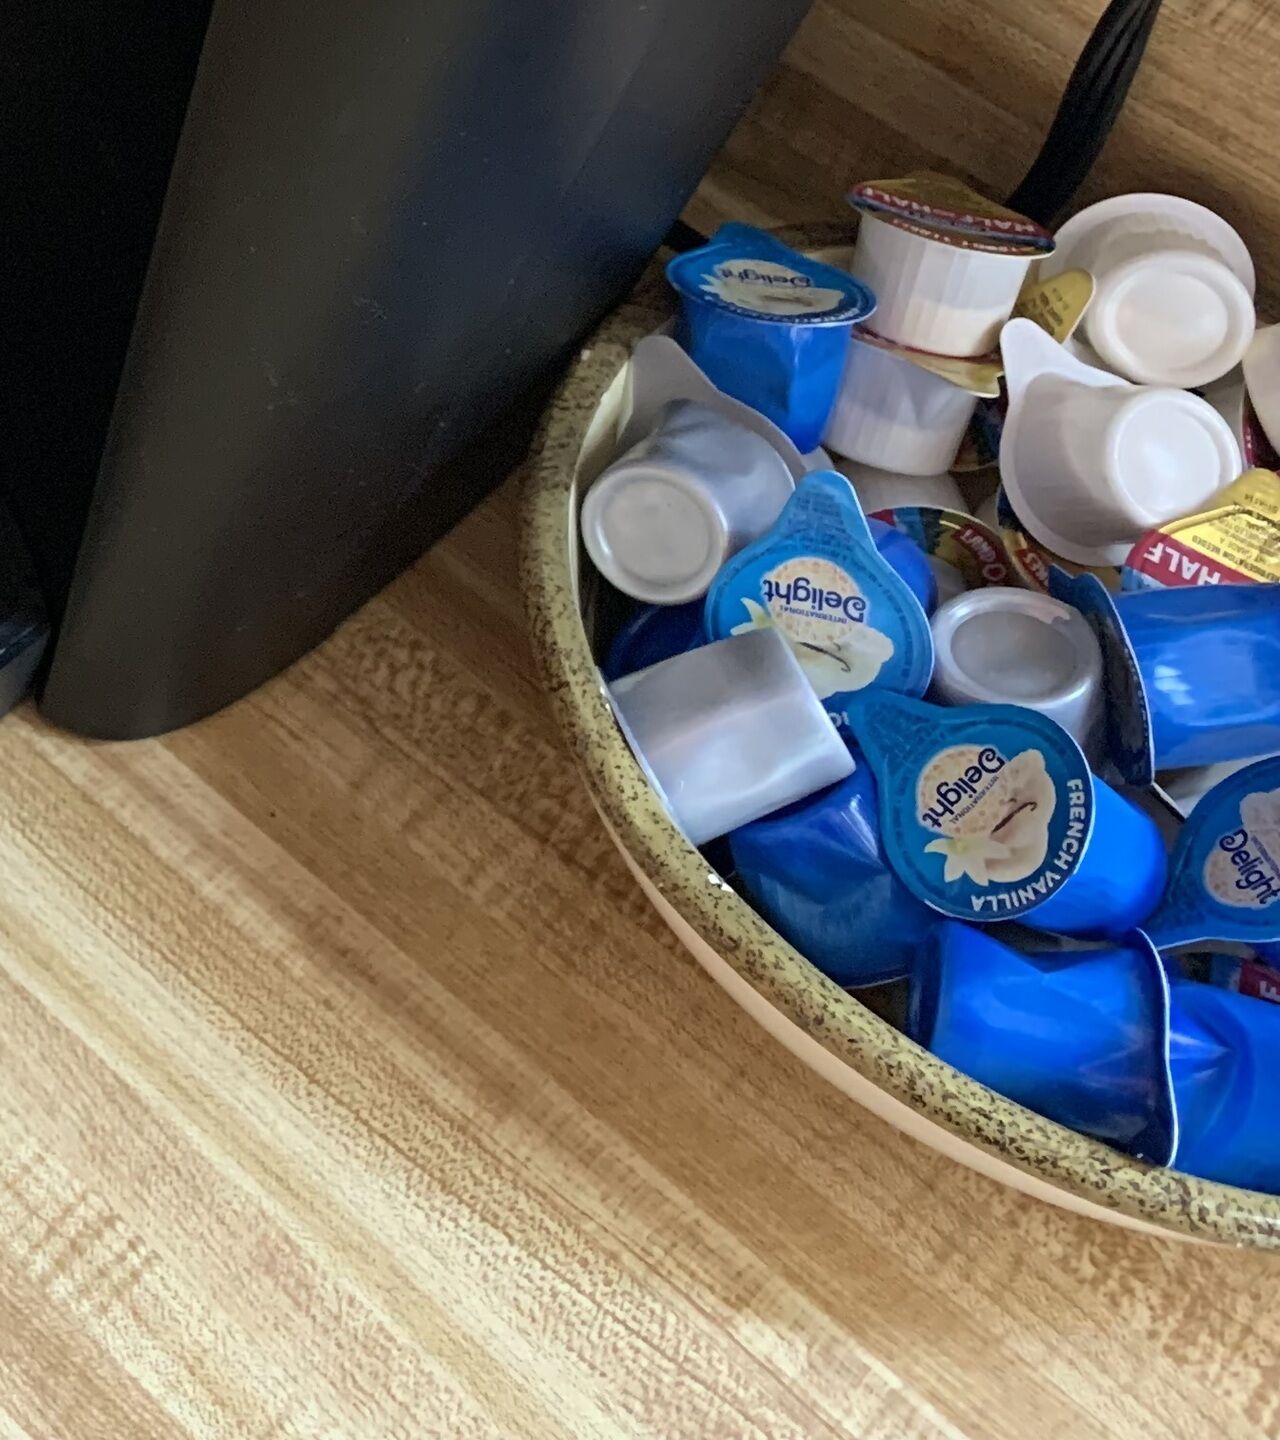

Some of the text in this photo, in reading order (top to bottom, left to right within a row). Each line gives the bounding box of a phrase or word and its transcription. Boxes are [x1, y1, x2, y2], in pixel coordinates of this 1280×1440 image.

[722, 268, 810, 288] Delight
[1144, 542, 1221, 585] HALF
[762, 577, 867, 623] Delight
[922, 748, 1006, 828] Delight
[971, 779, 1086, 912] FRENCH VANILLA
[1219, 828, 1280, 904] Delight
